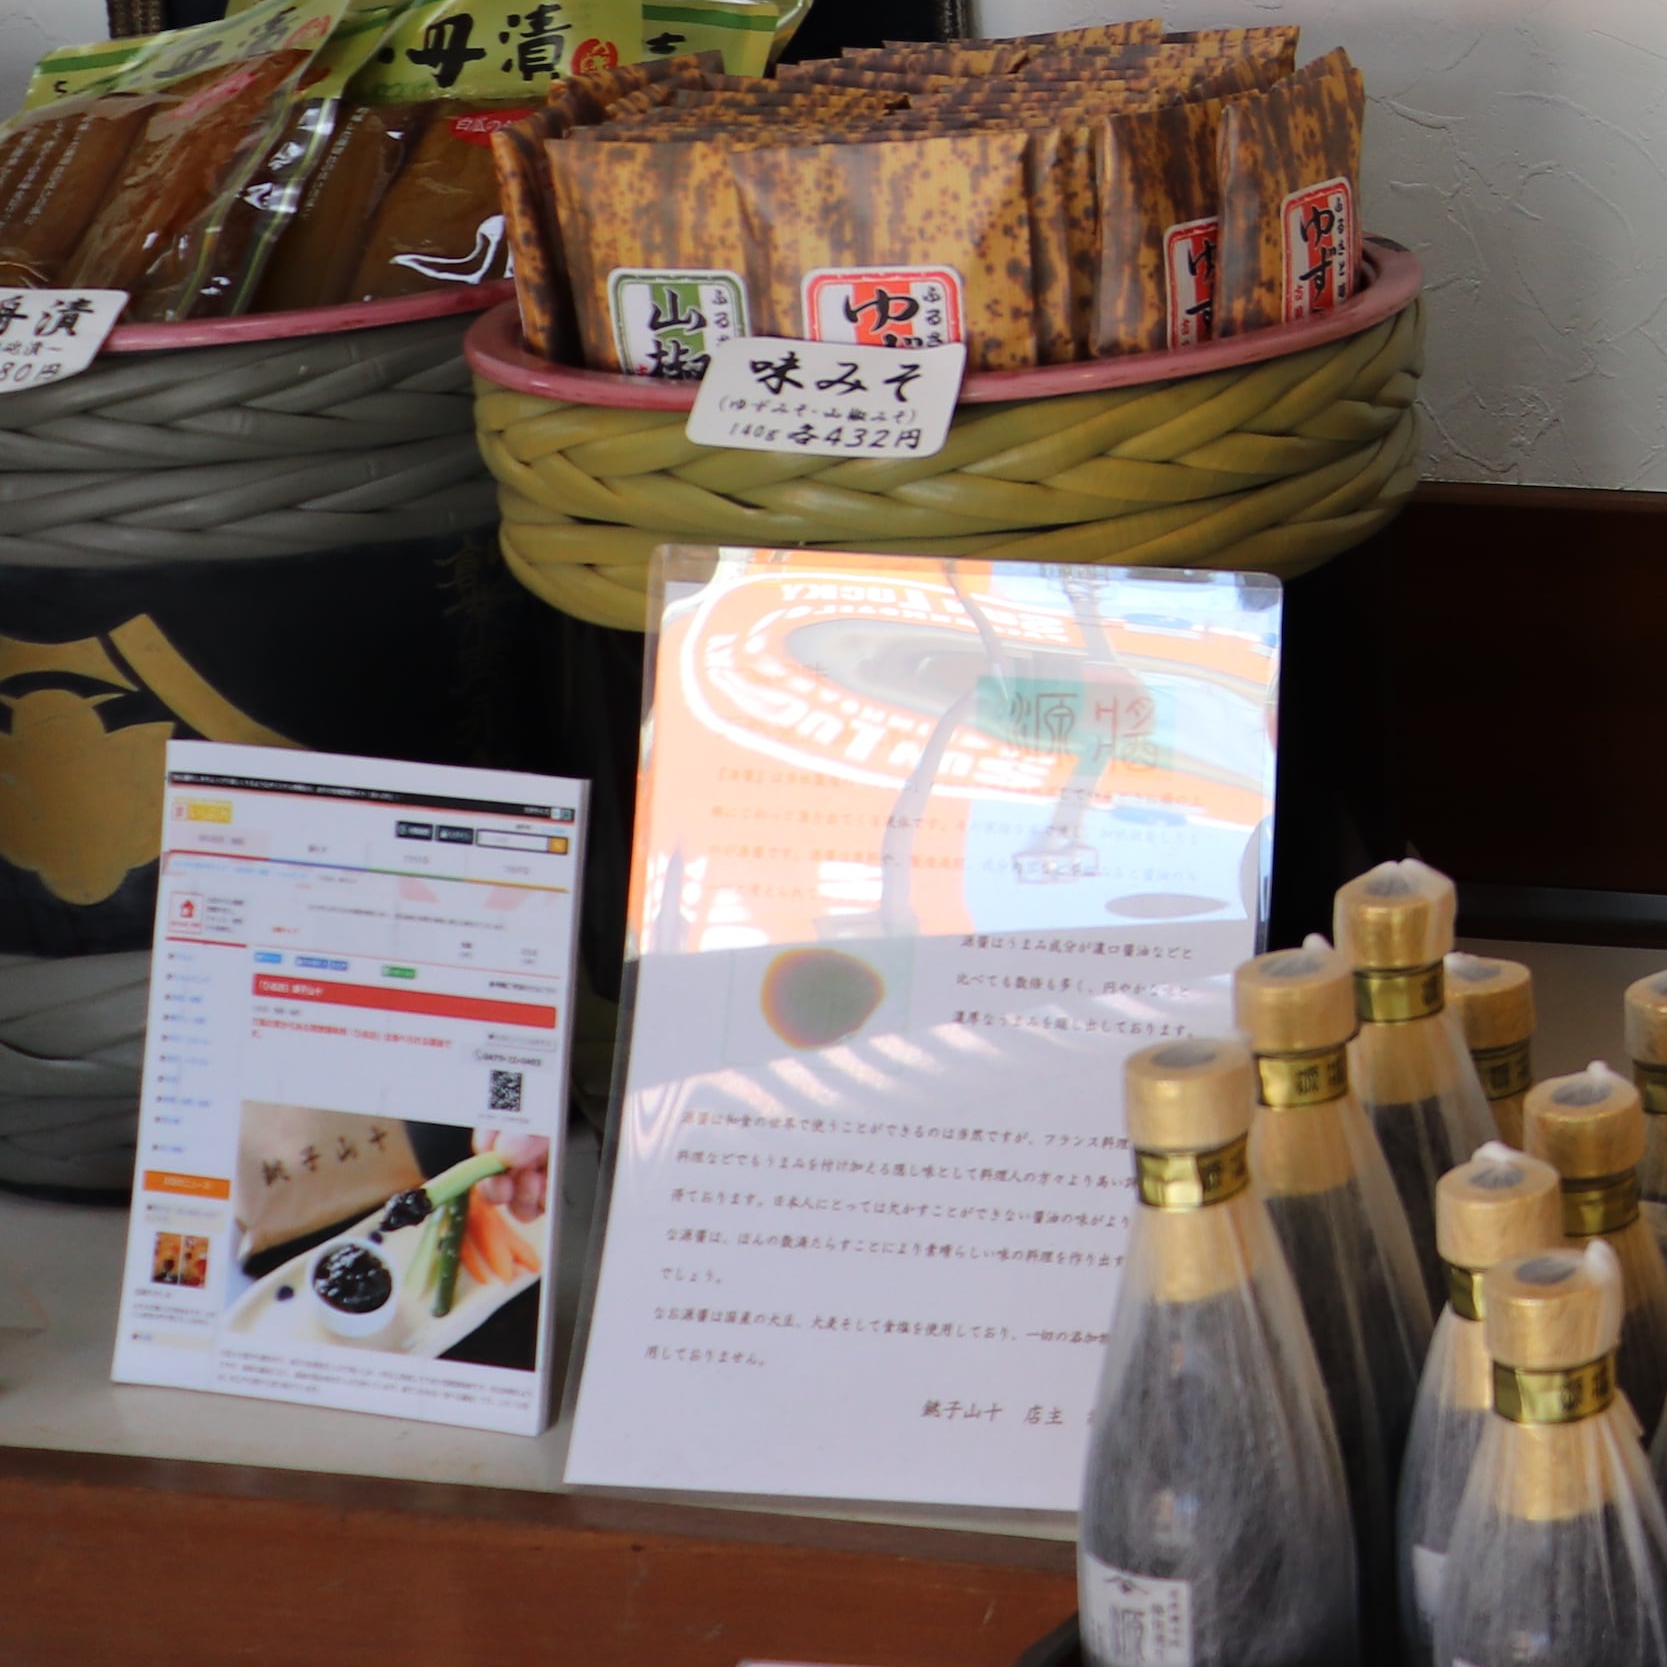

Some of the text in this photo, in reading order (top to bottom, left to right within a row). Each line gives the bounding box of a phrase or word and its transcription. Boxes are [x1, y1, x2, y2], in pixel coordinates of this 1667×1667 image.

[749, 350, 922, 403] 味みそ
[920, 1399, 1004, 1423] 銚子山十
[1024, 1403, 1064, 1426] 店主
